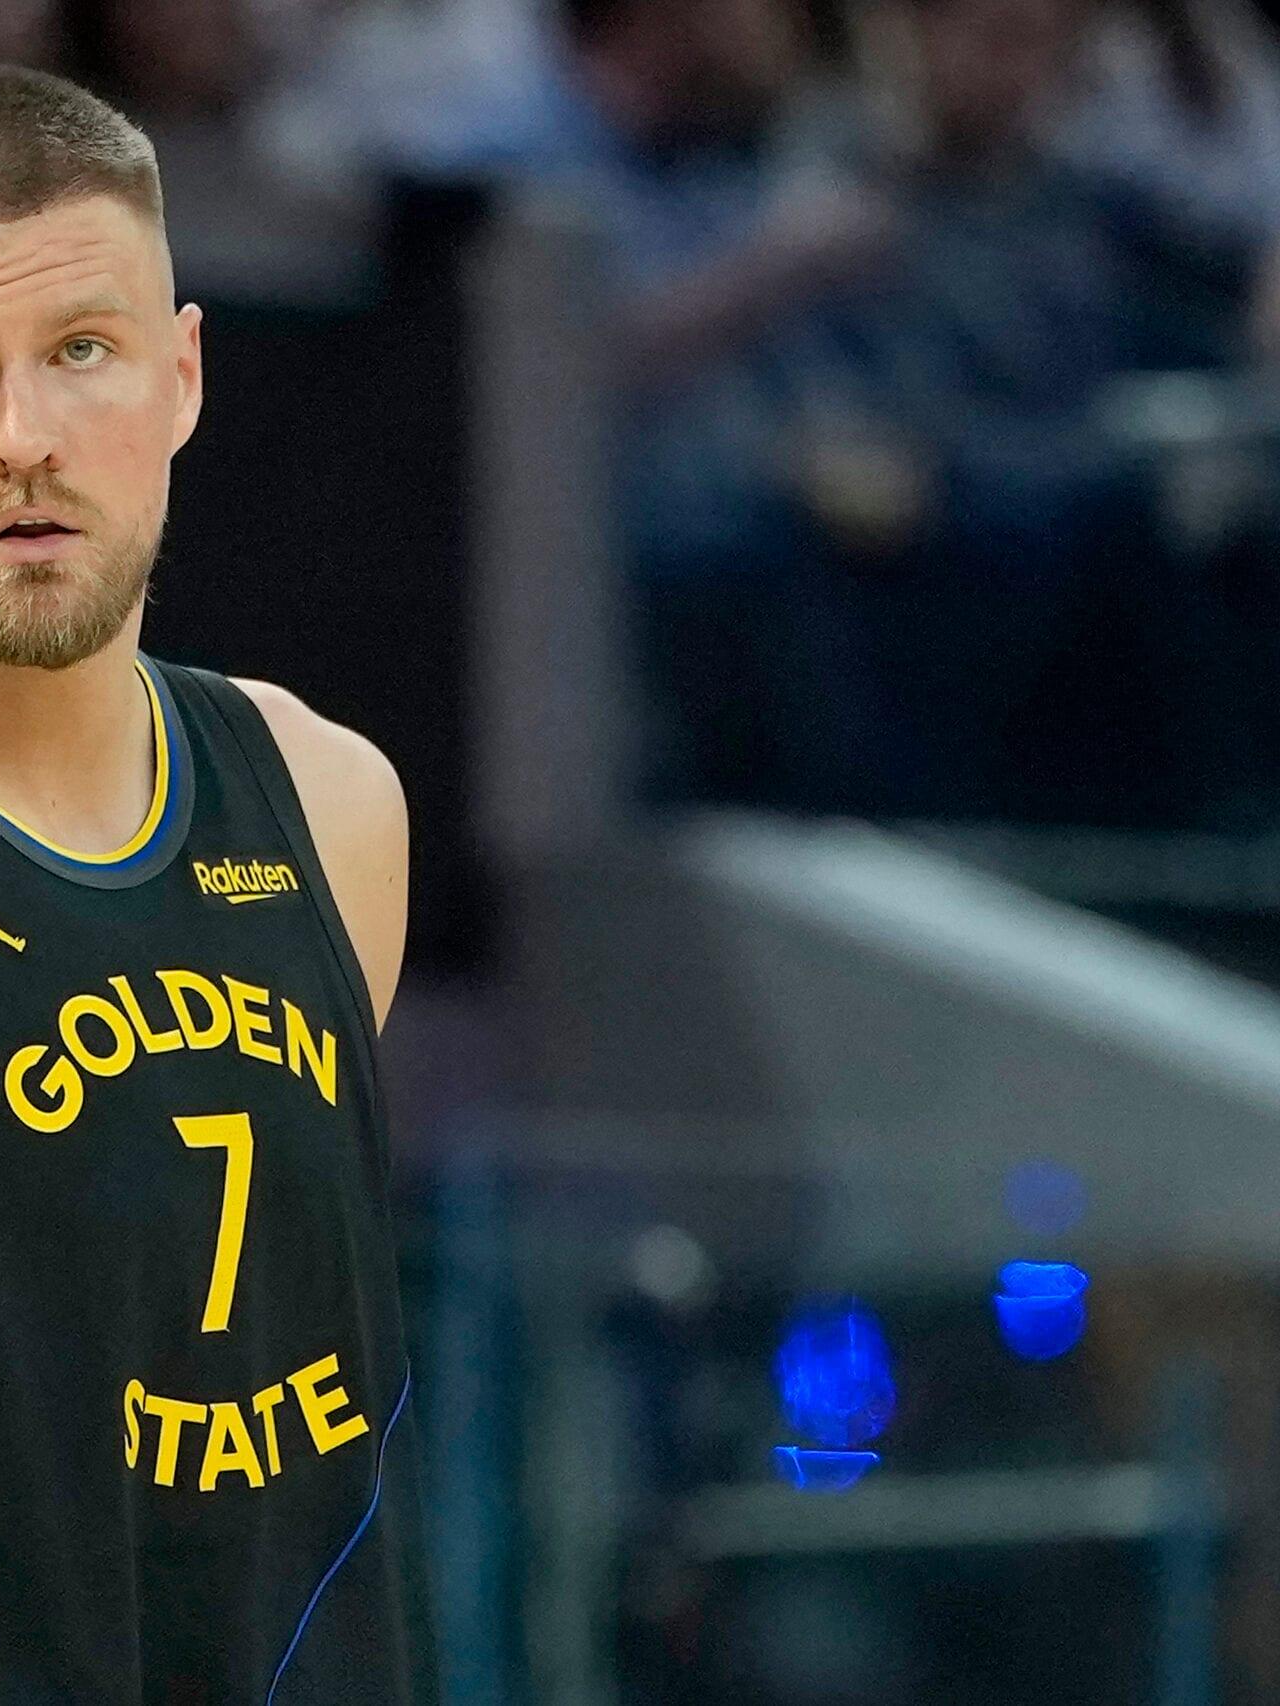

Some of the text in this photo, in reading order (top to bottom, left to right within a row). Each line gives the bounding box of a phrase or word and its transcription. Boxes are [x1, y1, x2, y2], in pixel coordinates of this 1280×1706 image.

[192, 857, 299, 895] Rakuten
[4, 969, 337, 1133] GOLDEN
[172, 1111, 254, 1333] 7
[122, 1353, 370, 1493] STATE
